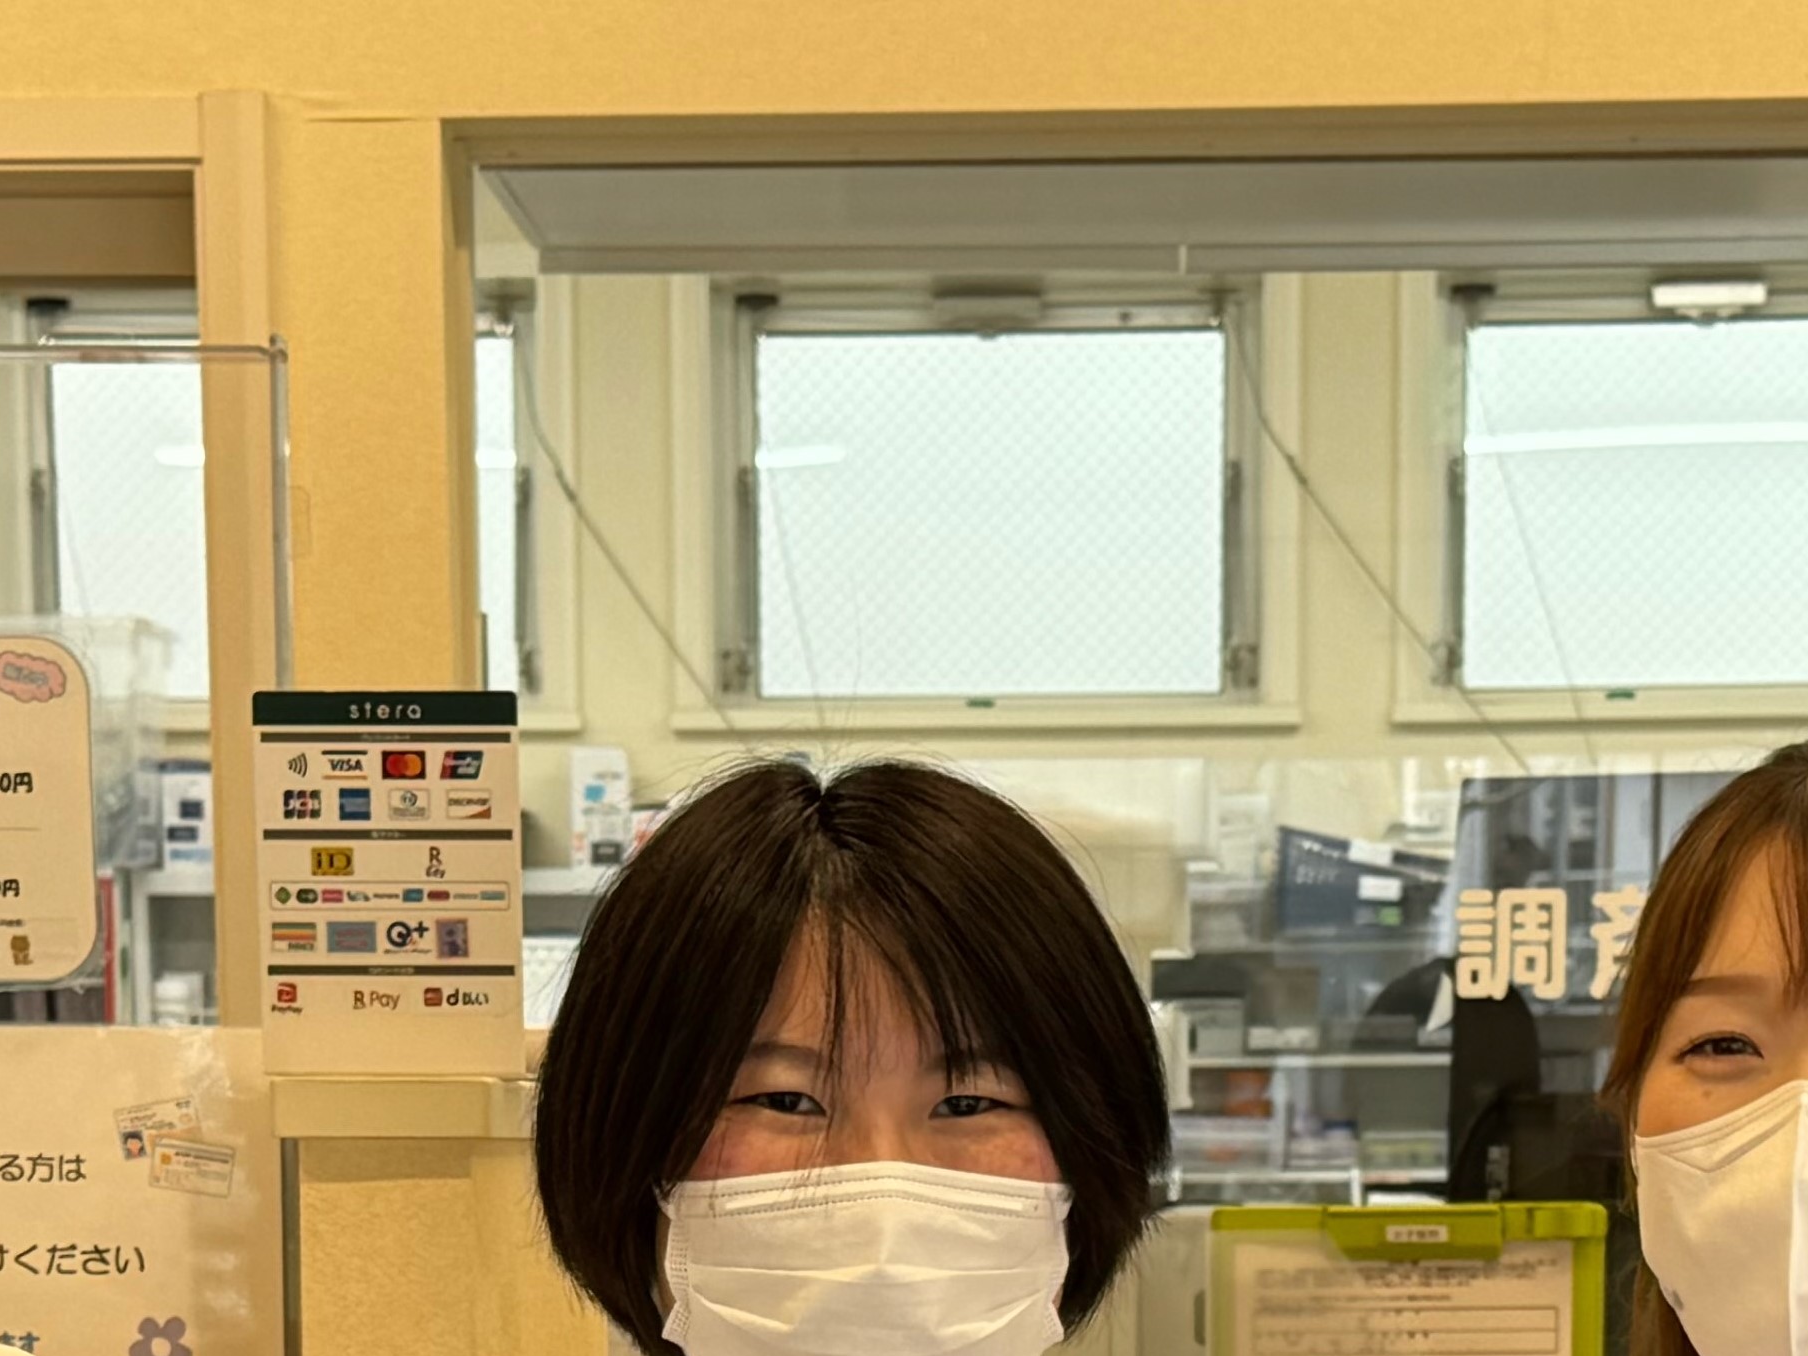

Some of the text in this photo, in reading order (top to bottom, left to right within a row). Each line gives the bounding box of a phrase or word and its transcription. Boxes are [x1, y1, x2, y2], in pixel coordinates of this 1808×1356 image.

[348, 701, 423, 720] stera
[328, 757, 365, 773] VISA
[315, 850, 354, 871] iD
[369, 990, 401, 1010] Pay
